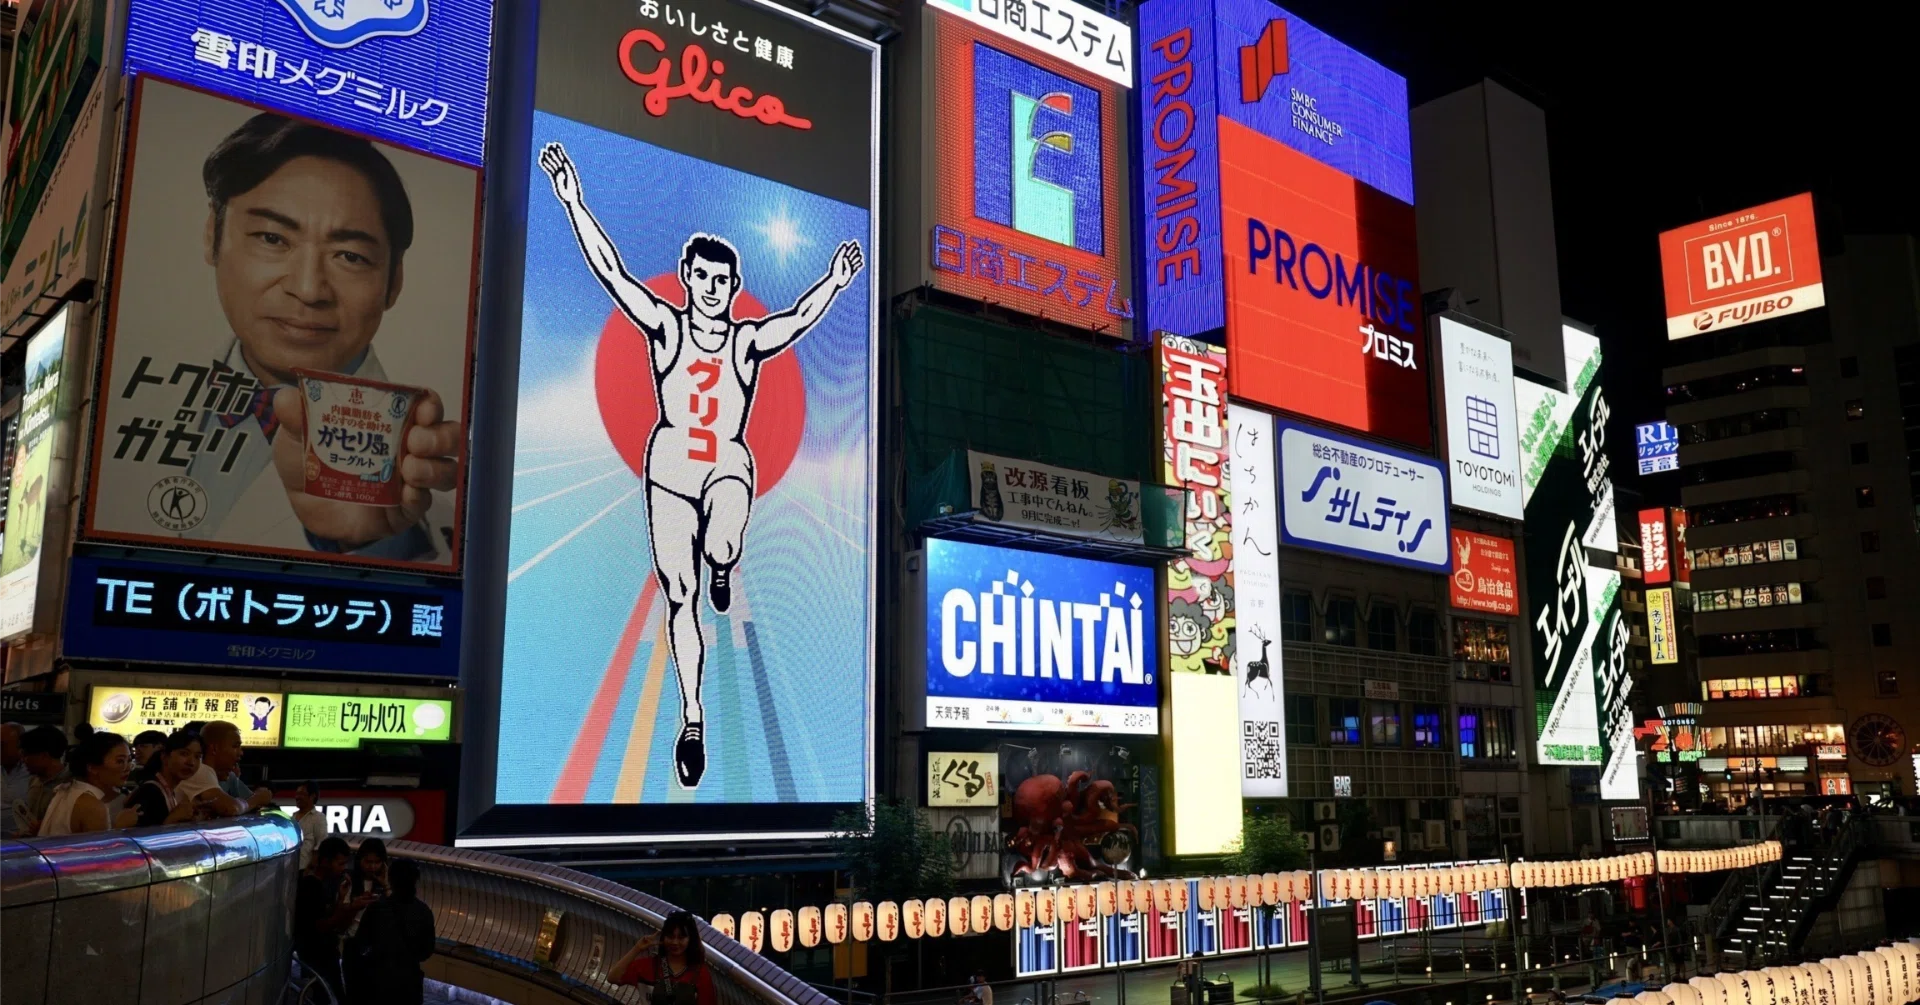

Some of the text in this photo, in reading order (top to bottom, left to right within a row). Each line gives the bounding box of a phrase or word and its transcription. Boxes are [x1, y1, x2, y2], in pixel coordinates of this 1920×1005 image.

[640, 0, 794, 70] おいしさと健康
[190, 27, 449, 127] 雪印メグミルク
[618, 28, 812, 130] Glico
[1290, 87, 1317, 111] SMBC
[1291, 102, 1343, 138] CONSUMER
[1292, 115, 1335, 146] FINANCE
[1152, 27, 1201, 286] PROMISE
[1708, 219, 1733, 232] Since
[931, 224, 1135, 320] 日商エステム
[1247, 217, 1416, 334] PROMISE
[1702, 230, 1781, 291] B.V.D.
[1717, 295, 1794, 324] FUJIBO
[1359, 324, 1418, 370] プロミス
[121, 356, 259, 416] トクホ
[348, 387, 365, 405] 恵
[176, 408, 198, 425] の
[687, 356, 724, 464] グリコ
[1578, 392, 1611, 466] エイブル
[113, 417, 250, 474] ガセリ
[329, 453, 375, 469] ヨーグルト
[1312, 443, 1425, 482] 総合不動産のプロデューサー
[1003, 465, 1091, 501] 改源看板
[1236, 422, 1273, 557] はちかん
[1472, 484, 1502, 498] HOLDINGS
[1008, 491, 1094, 518] 工事中でんねん。
[1325, 486, 1411, 535] サムティ
[1652, 520, 1668, 572] カラオケ
[1536, 534, 1590, 662] エイブル
[227, 644, 317, 660] 雪印メグミルク
[941, 579, 1145, 685] CHINTAI
[1651, 609, 1665, 660] ネットルーム
[1596, 617, 1631, 698] エイブル
[0, 695, 40, 710] ilets
[141, 689, 240, 699] KANSAI INVEST CORPORATION
[141, 696, 240, 713] 店舗情報館
[935, 705, 970, 721] 天気予報
[291, 703, 338, 728] 賃貸・売買
[340, 701, 407, 734] ピタットハウス
[941, 758, 986, 799] くくる
[1333, 775, 1351, 790] BAR
